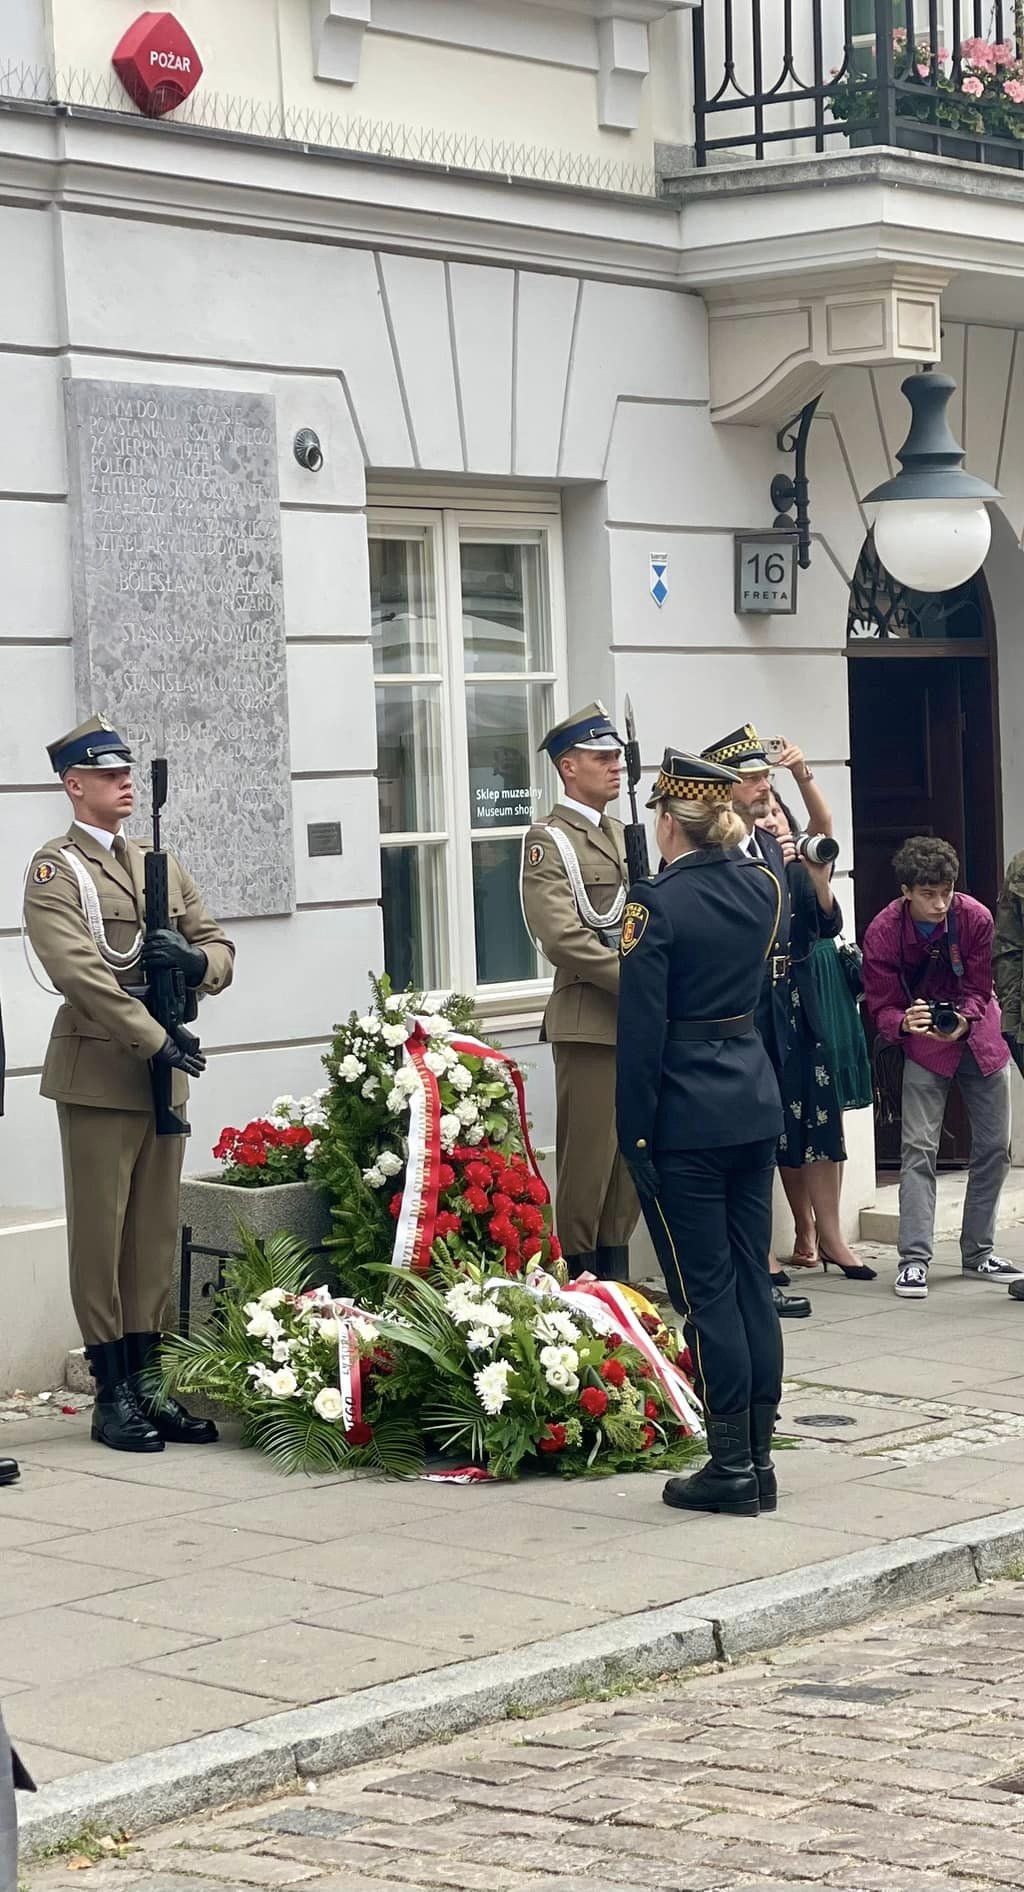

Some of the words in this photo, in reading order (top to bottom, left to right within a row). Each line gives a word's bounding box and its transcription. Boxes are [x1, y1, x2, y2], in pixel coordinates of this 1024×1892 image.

[150, 50, 191, 73] POŻAR
[105, 397, 134, 417] TYM
[136, 399, 178, 421] DOMU
[89, 414, 165, 440] POWSTANIA
[90, 435, 106, 455] 26
[112, 436, 175, 459] SIERPNIA
[179, 441, 209, 461] 1944
[90, 454, 144, 475] POLEGLI
[747, 552, 785, 584] 16
[120, 571, 197, 593] BOLESŁAW
[203, 574, 273, 595] KOWALSKI
[221, 595, 274, 612] RYSZARD
[743, 590, 788, 600] FRETA
[121, 622, 209, 643] STANISŁAW
[123, 672, 206, 693] STANISŁAW
[476, 788, 500, 802] Sklep
[501, 786, 543, 799] muzealny
[477, 805, 513, 817] Museum
[514, 803, 535, 817] shop
